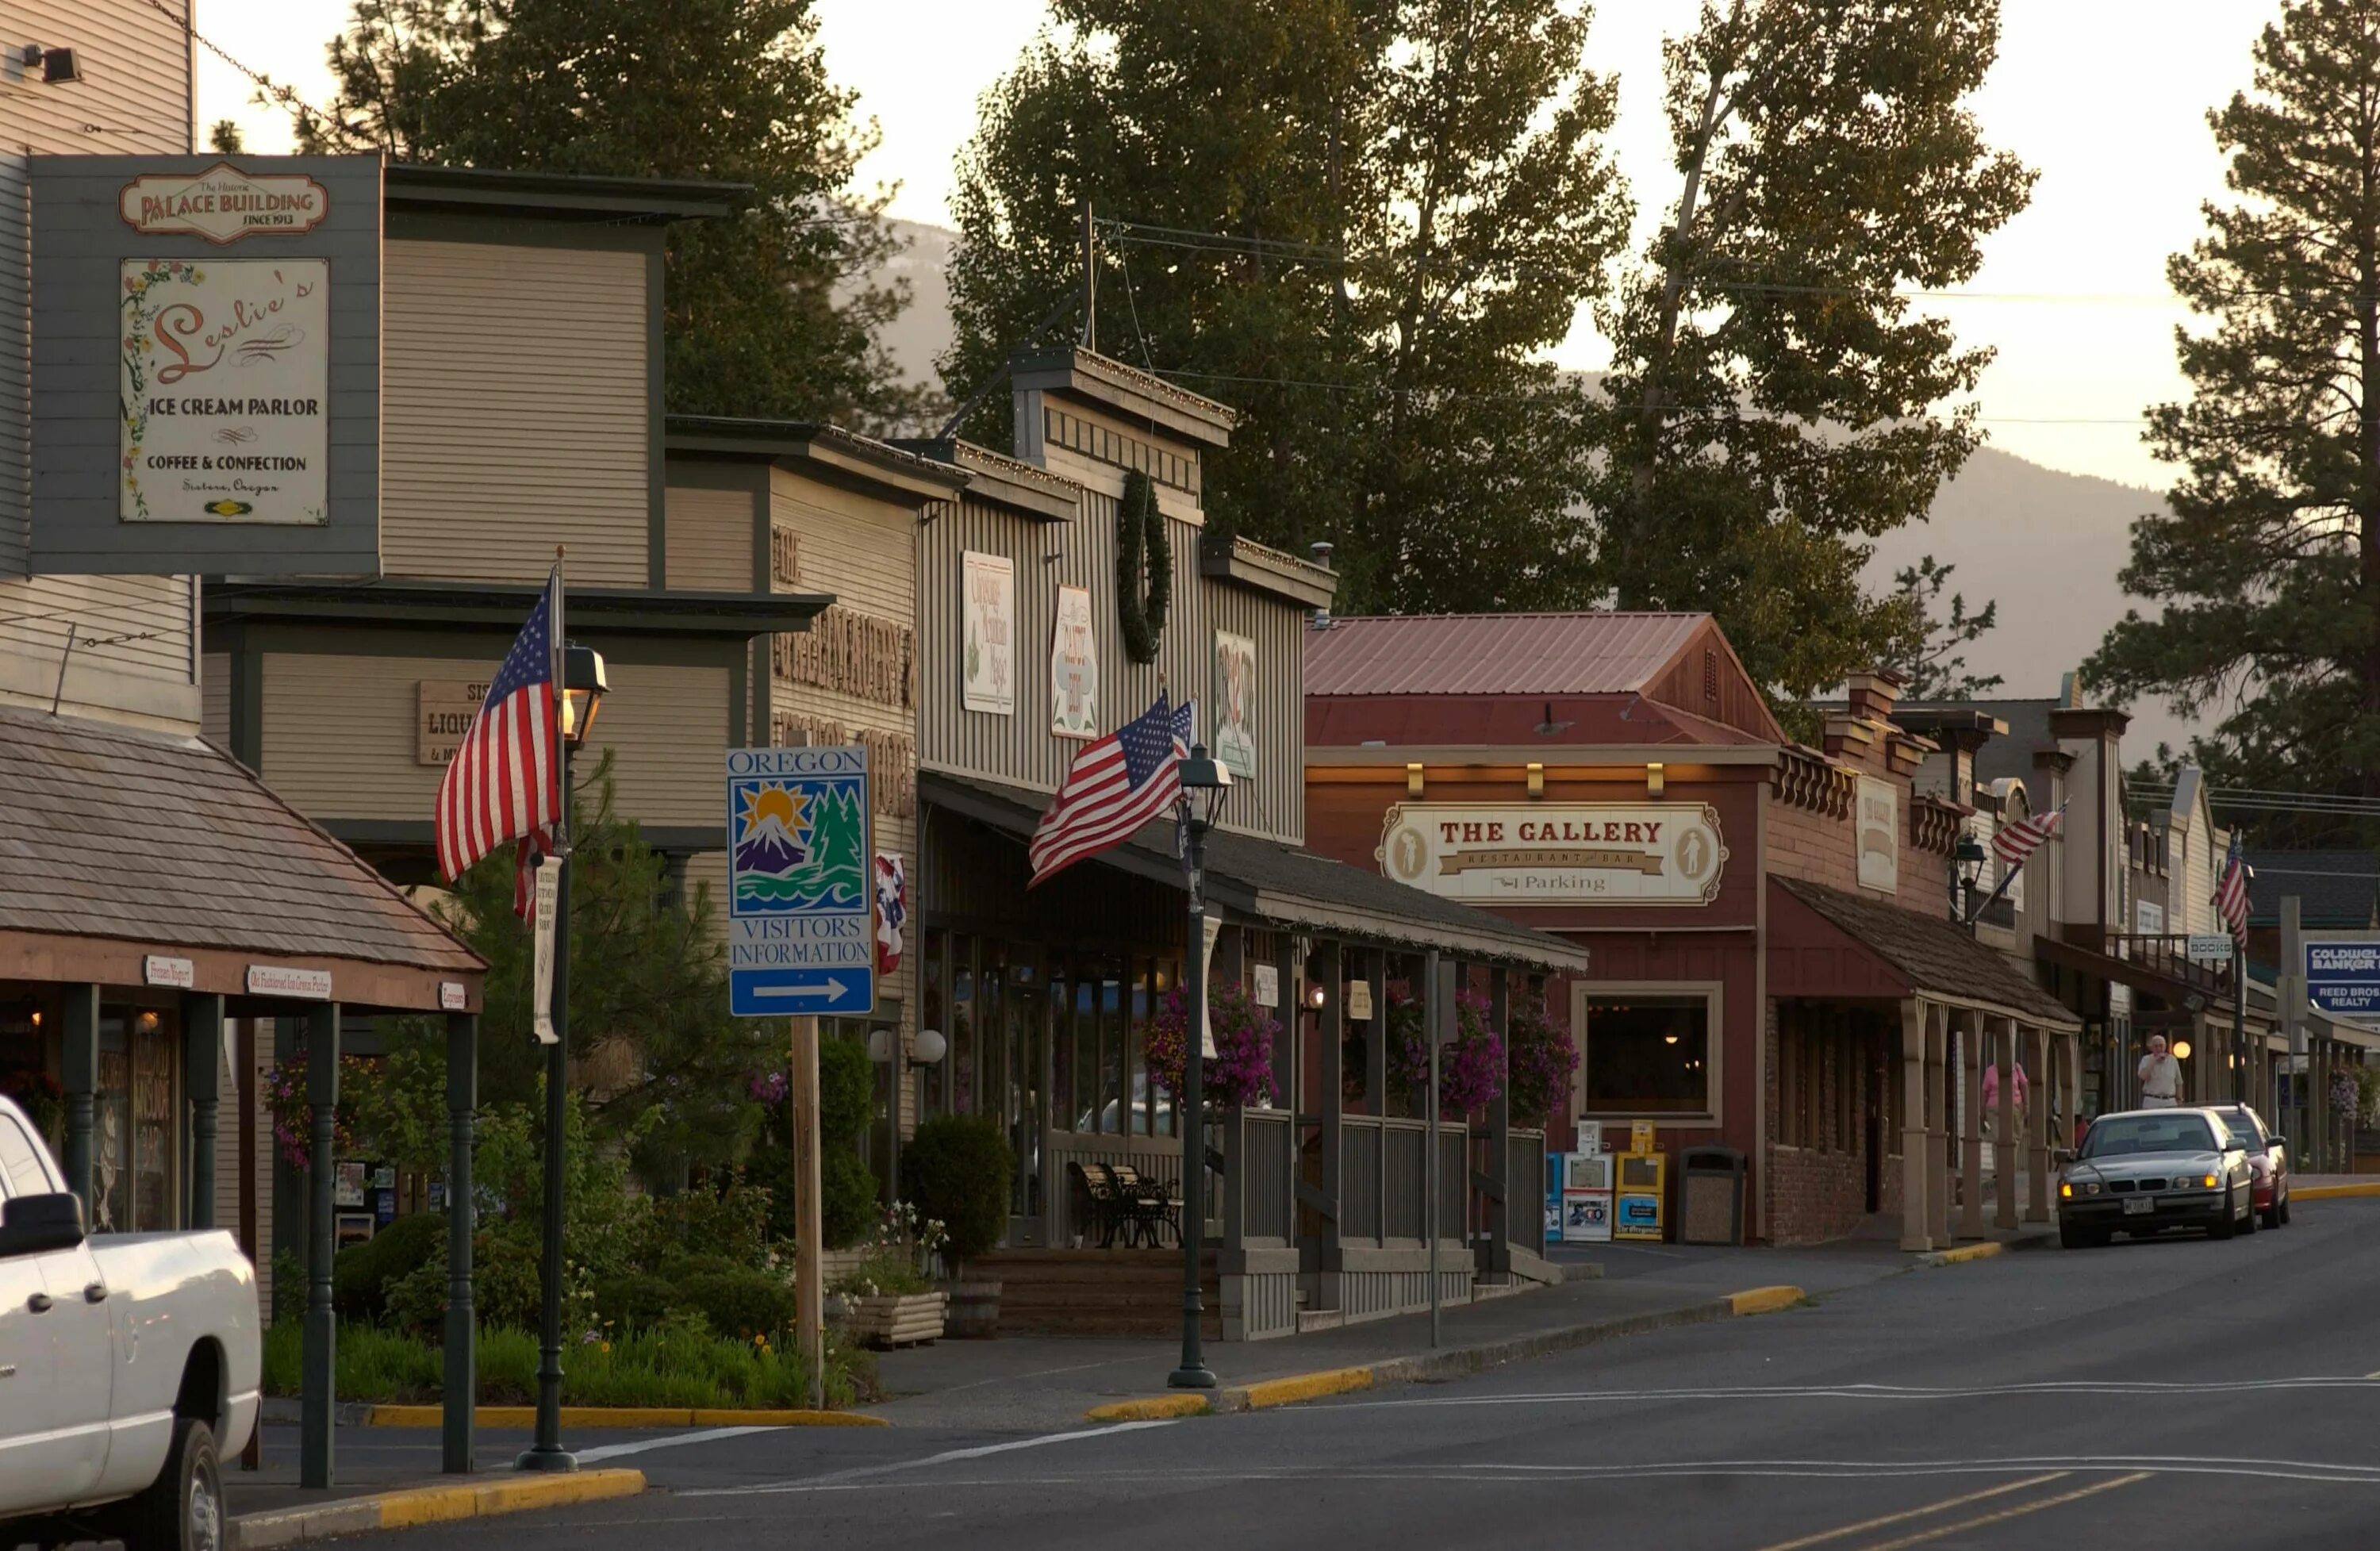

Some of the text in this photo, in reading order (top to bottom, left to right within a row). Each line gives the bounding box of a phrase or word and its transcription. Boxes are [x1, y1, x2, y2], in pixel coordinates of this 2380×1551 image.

[140, 193, 314, 226] PALACE BUILDING
[243, 214, 293, 225] SINCE 1913
[154, 269, 313, 385] Leslie's
[149, 398, 318, 416] ICE CREAM PARLOR
[147, 455, 306, 470] COFFEE & CONFECTION
[232, 478, 279, 497] Oregon
[728, 750, 864, 774] OREGON
[1440, 822, 1664, 843] THE GALLERY
[1468, 852, 1581, 864] RESTAURANT
[1603, 853, 1633, 864] BAR
[1526, 875, 1606, 893] Parking
[743, 917, 861, 940] VISITORS
[732, 941, 871, 966] INFORMATION
[2312, 958, 2376, 971] BANKER
[2319, 988, 2348, 997] REED
[2331, 997, 2371, 1007] REALTY
